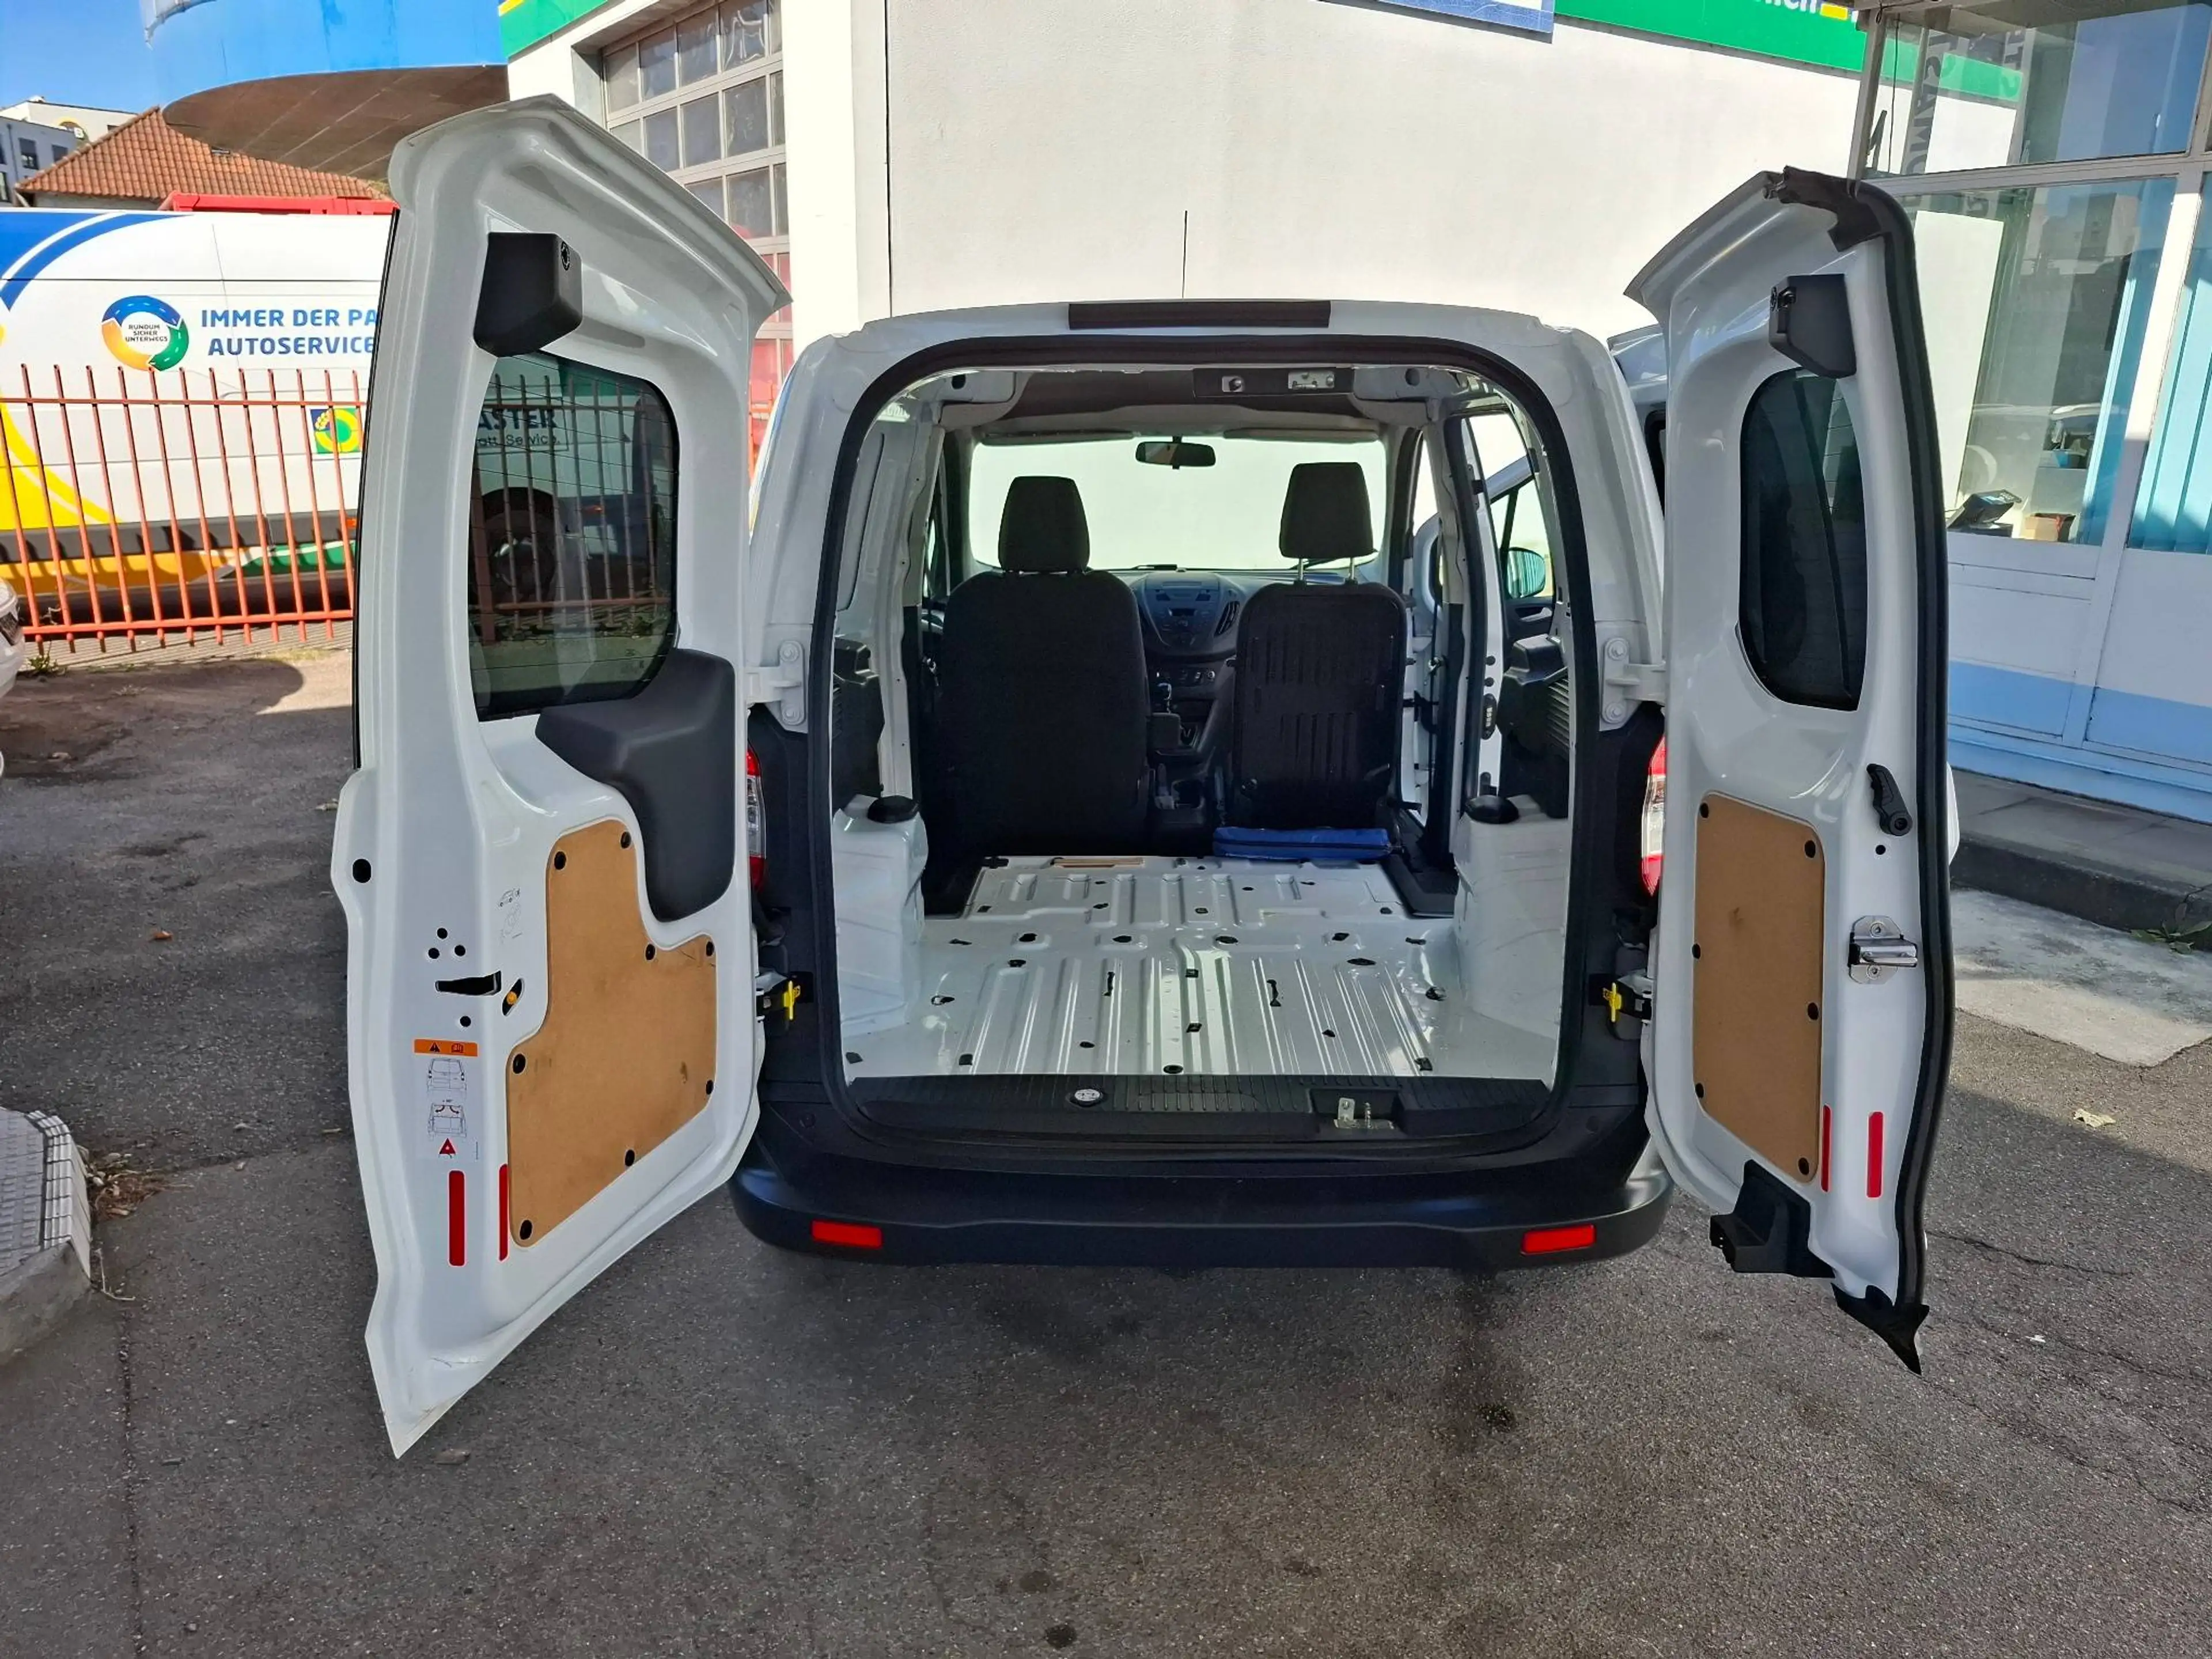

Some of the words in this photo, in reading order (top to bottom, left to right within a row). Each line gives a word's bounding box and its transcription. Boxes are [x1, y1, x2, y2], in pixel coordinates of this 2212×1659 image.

[201, 309, 285, 327] IMMER
[292, 309, 340, 327] DER
[348, 309, 377, 326] PA
[207, 337, 374, 355] AUTOSERVICE
[506, 434, 560, 446] Sevic.
